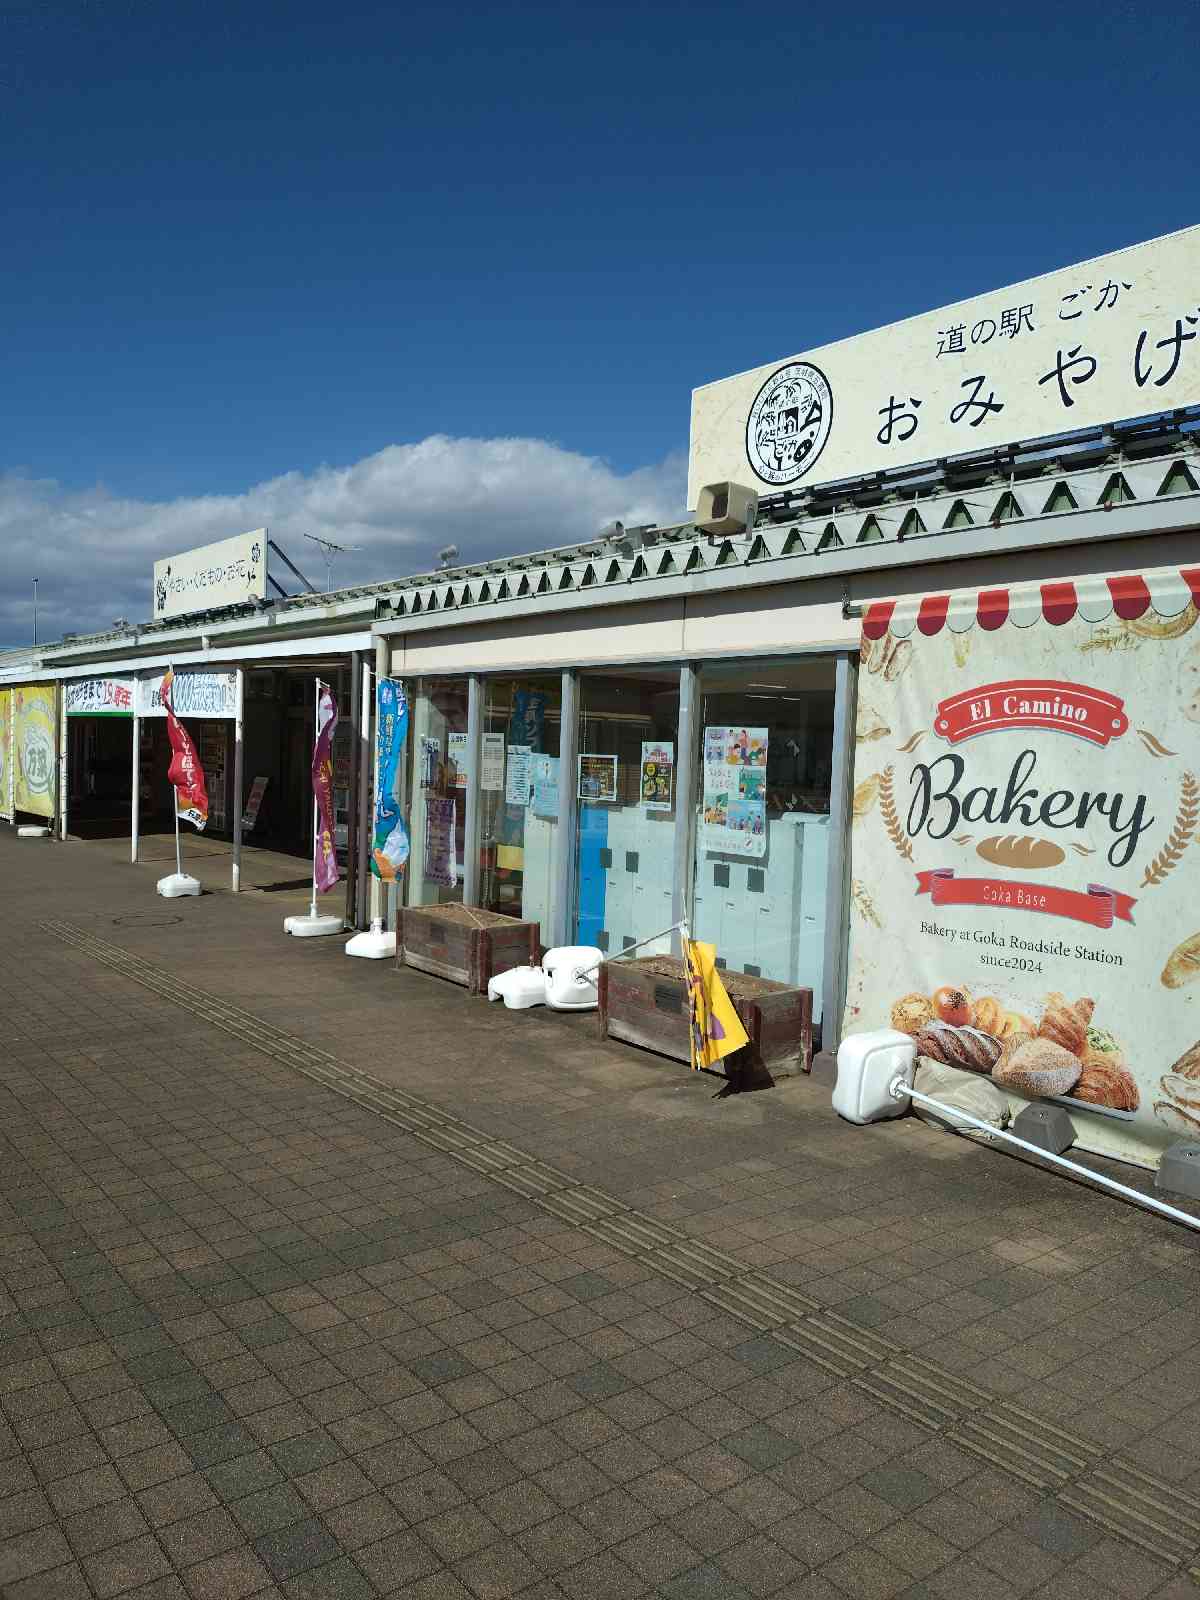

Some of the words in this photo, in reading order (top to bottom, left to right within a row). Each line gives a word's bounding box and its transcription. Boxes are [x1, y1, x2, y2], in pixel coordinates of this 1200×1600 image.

[936, 303, 1035, 358] 道の駅
[1059, 279, 1132, 320] ごか
[877, 306, 1200, 445] おみやげ
[970, 699, 991, 721] El
[1003, 696, 1088, 721] Camino
[906, 749, 1154, 867] Bakery
[1017, 889, 1046, 907] Base
[920, 921, 957, 943] Bakery
[959, 929, 971, 941] at
[973, 930, 1005, 947] Goka
[1010, 935, 1071, 957] Roadside
[1075, 945, 1123, 966] Station
